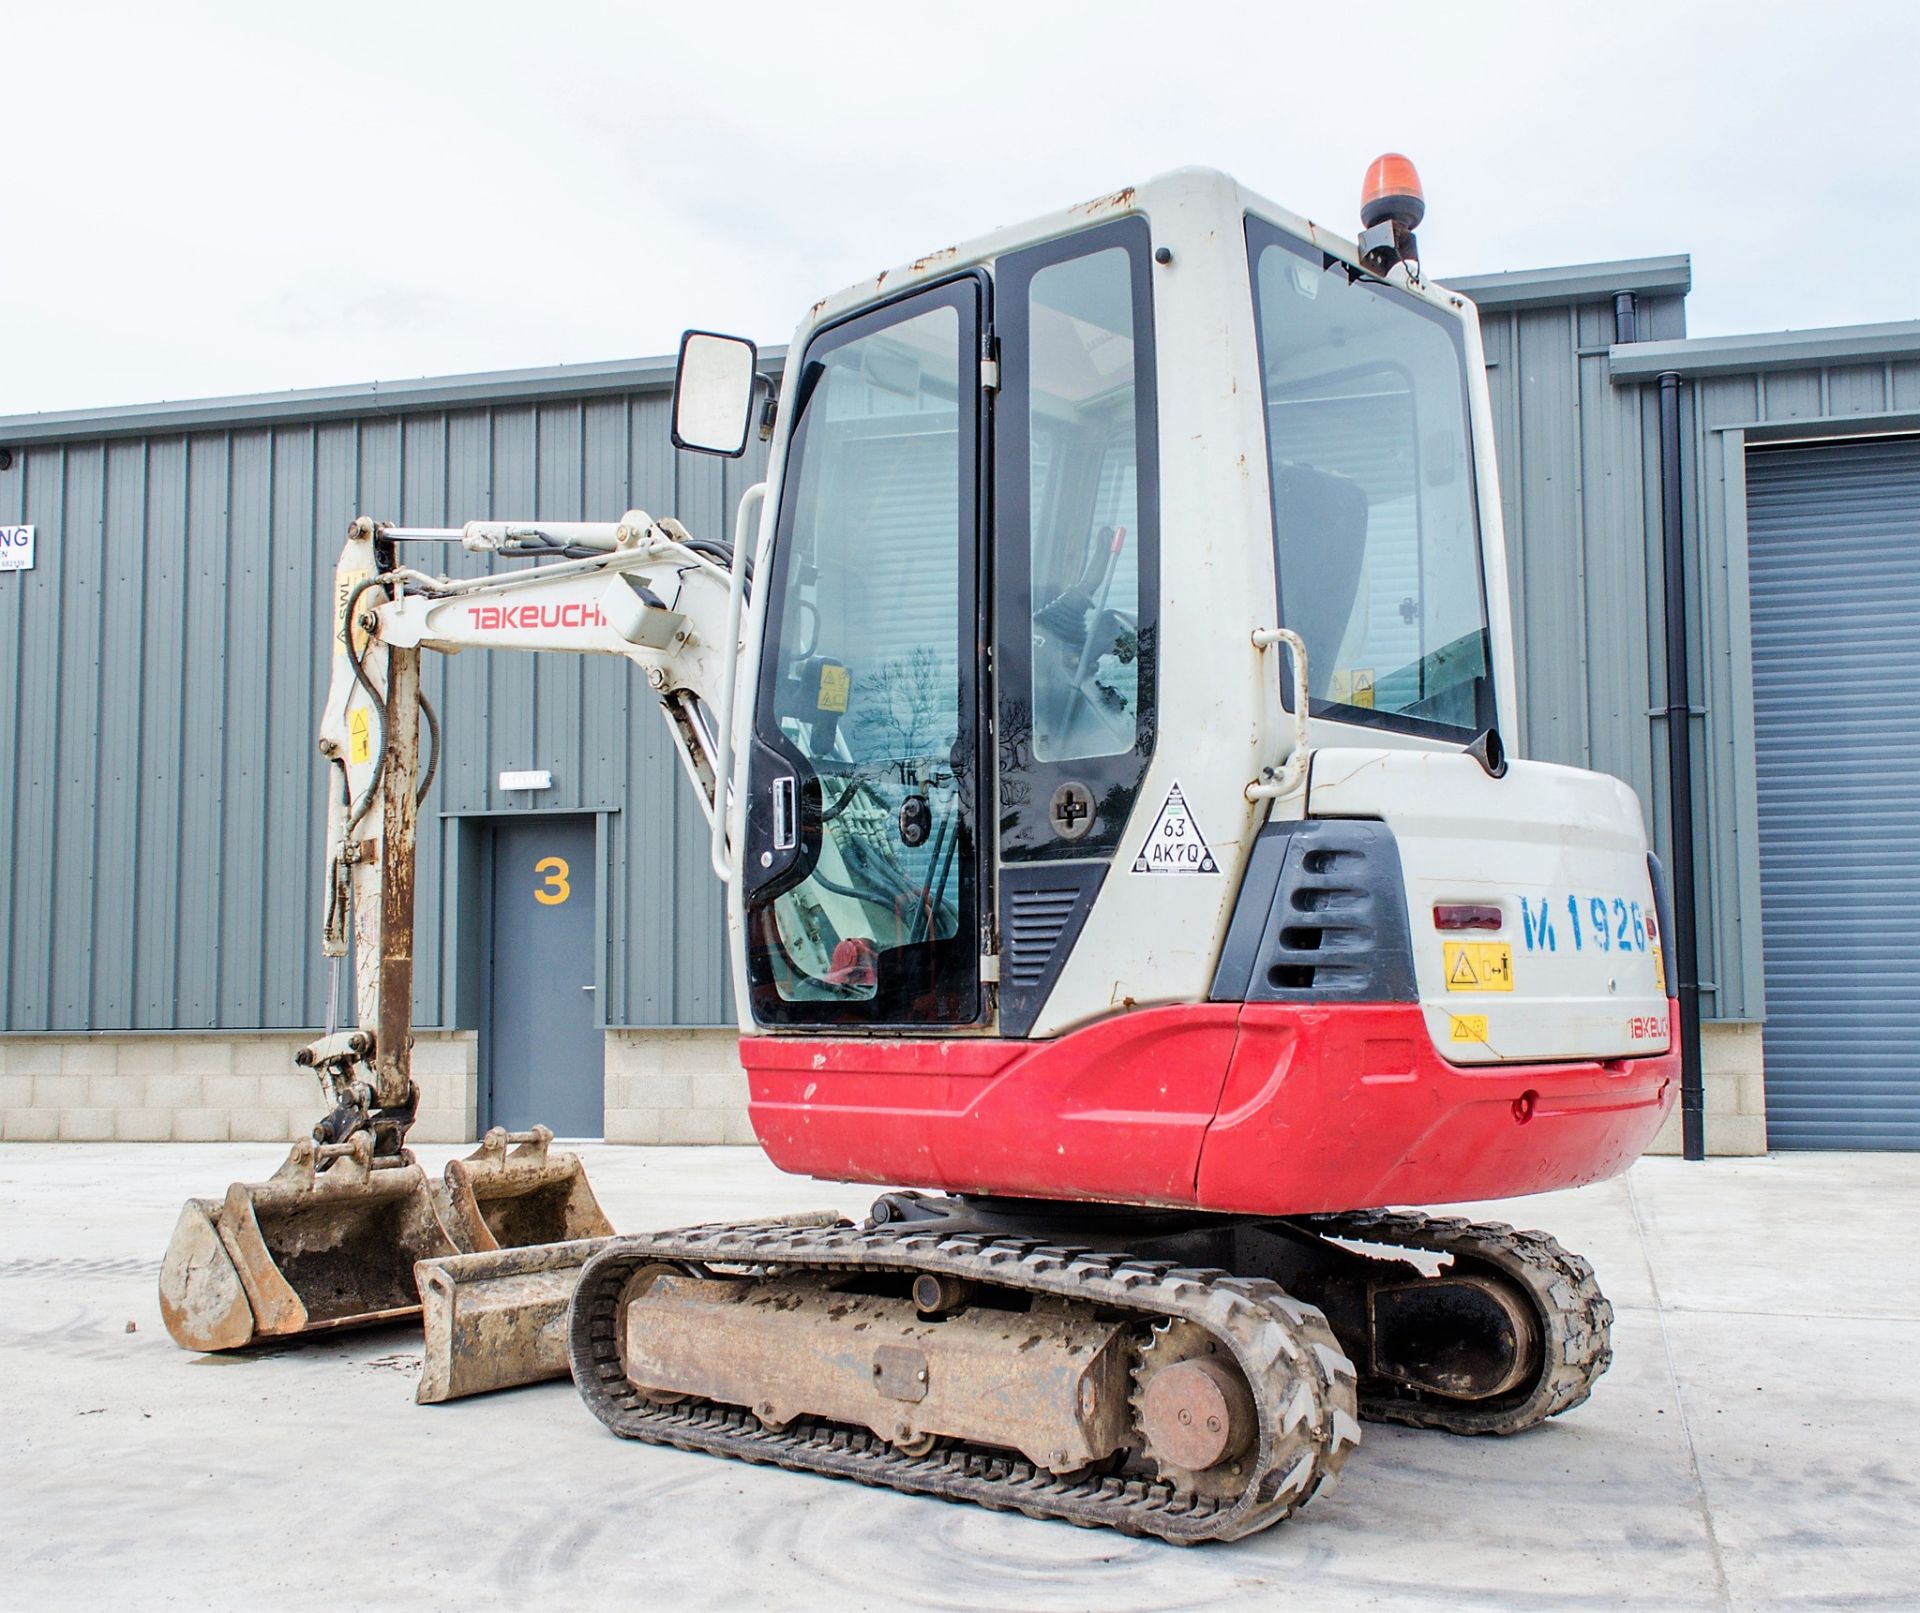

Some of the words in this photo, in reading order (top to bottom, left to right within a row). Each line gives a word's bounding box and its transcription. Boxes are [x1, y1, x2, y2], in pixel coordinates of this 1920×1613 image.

[1164, 819, 1185, 837] 63
[1153, 843, 1198, 863] AK7Q
[534, 856, 570, 905] 3
[1626, 1016, 1668, 1039] TAKEU
